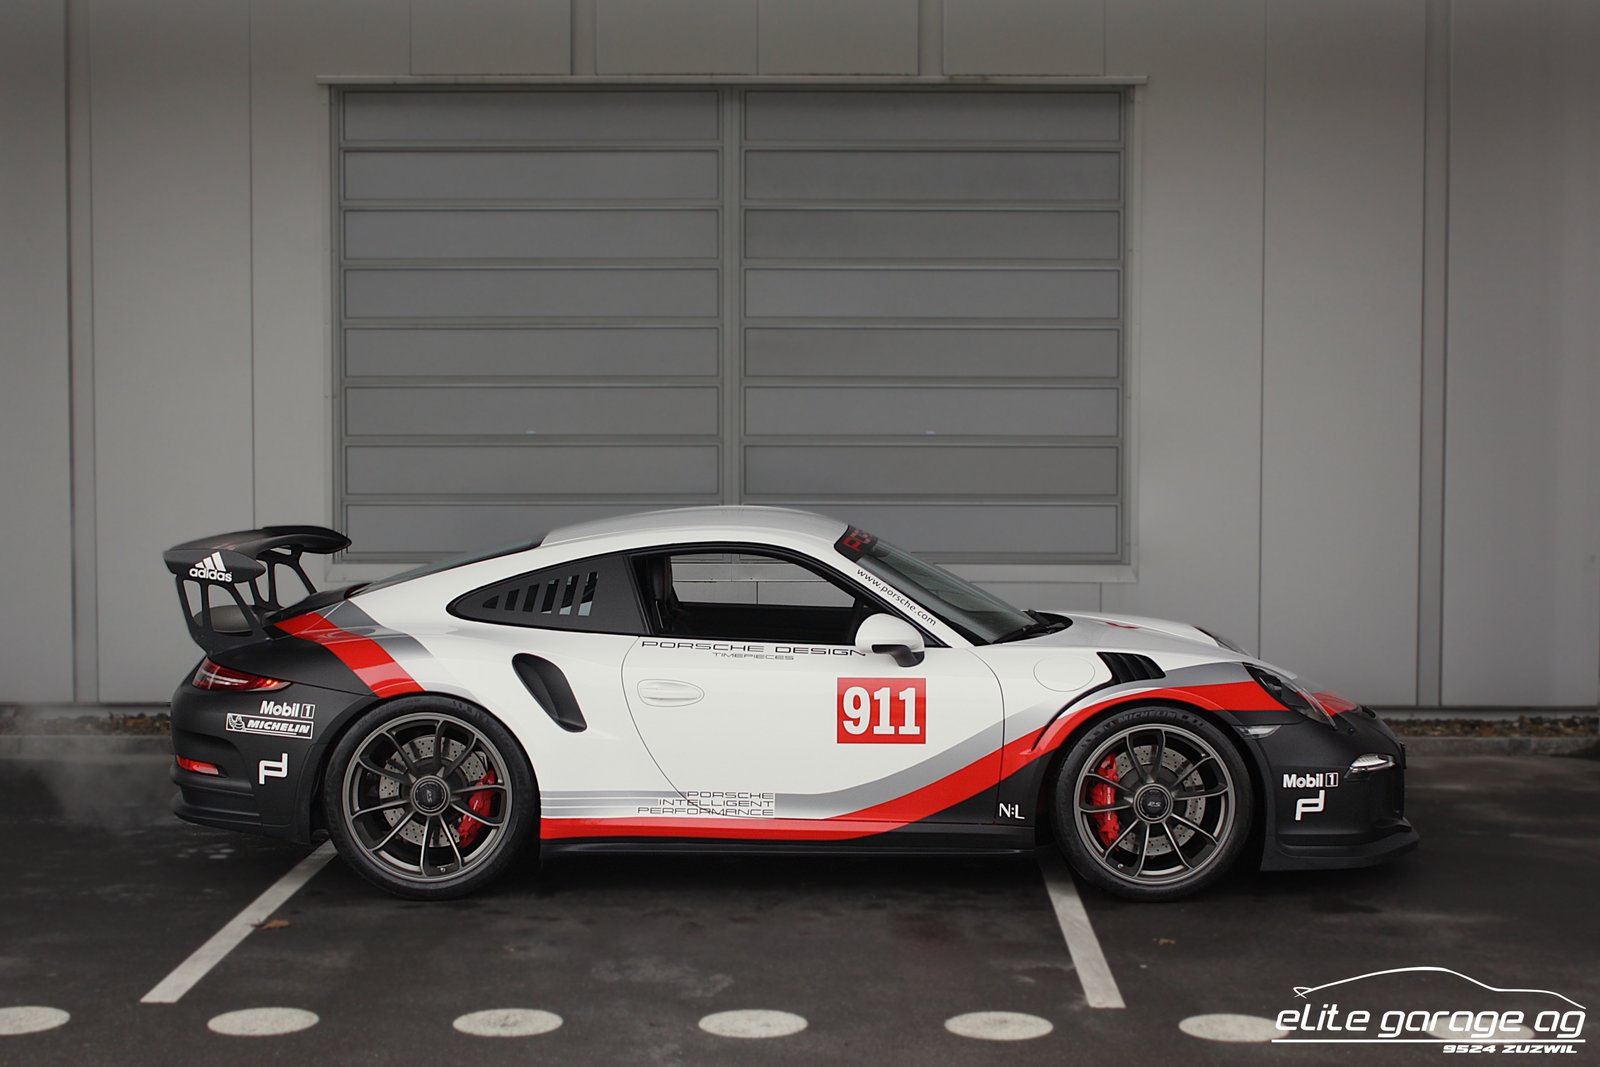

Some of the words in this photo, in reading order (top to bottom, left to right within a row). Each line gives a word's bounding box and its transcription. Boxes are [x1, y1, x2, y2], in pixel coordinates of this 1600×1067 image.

[189, 567, 232, 582] adidas
[857, 569, 937, 626] www.porsche.com
[642, 641, 765, 652] PORSCHE
[775, 646, 866, 656] DESIGN
[713, 652, 794, 660] TIMEPIECES
[260, 700, 300, 717] Mobil
[301, 703, 316, 719] 1
[842, 686, 920, 735] 911
[1118, 710, 1178, 724] MICHELIN
[247, 720, 310, 734] MICHELIN
[1283, 773, 1324, 788] Mobil
[1325, 772, 1339, 787] 1
[687, 791, 774, 799] PORSCHE
[659, 799, 774, 807] INTELLIGENT
[637, 807, 774, 816] PERFORMANCE
